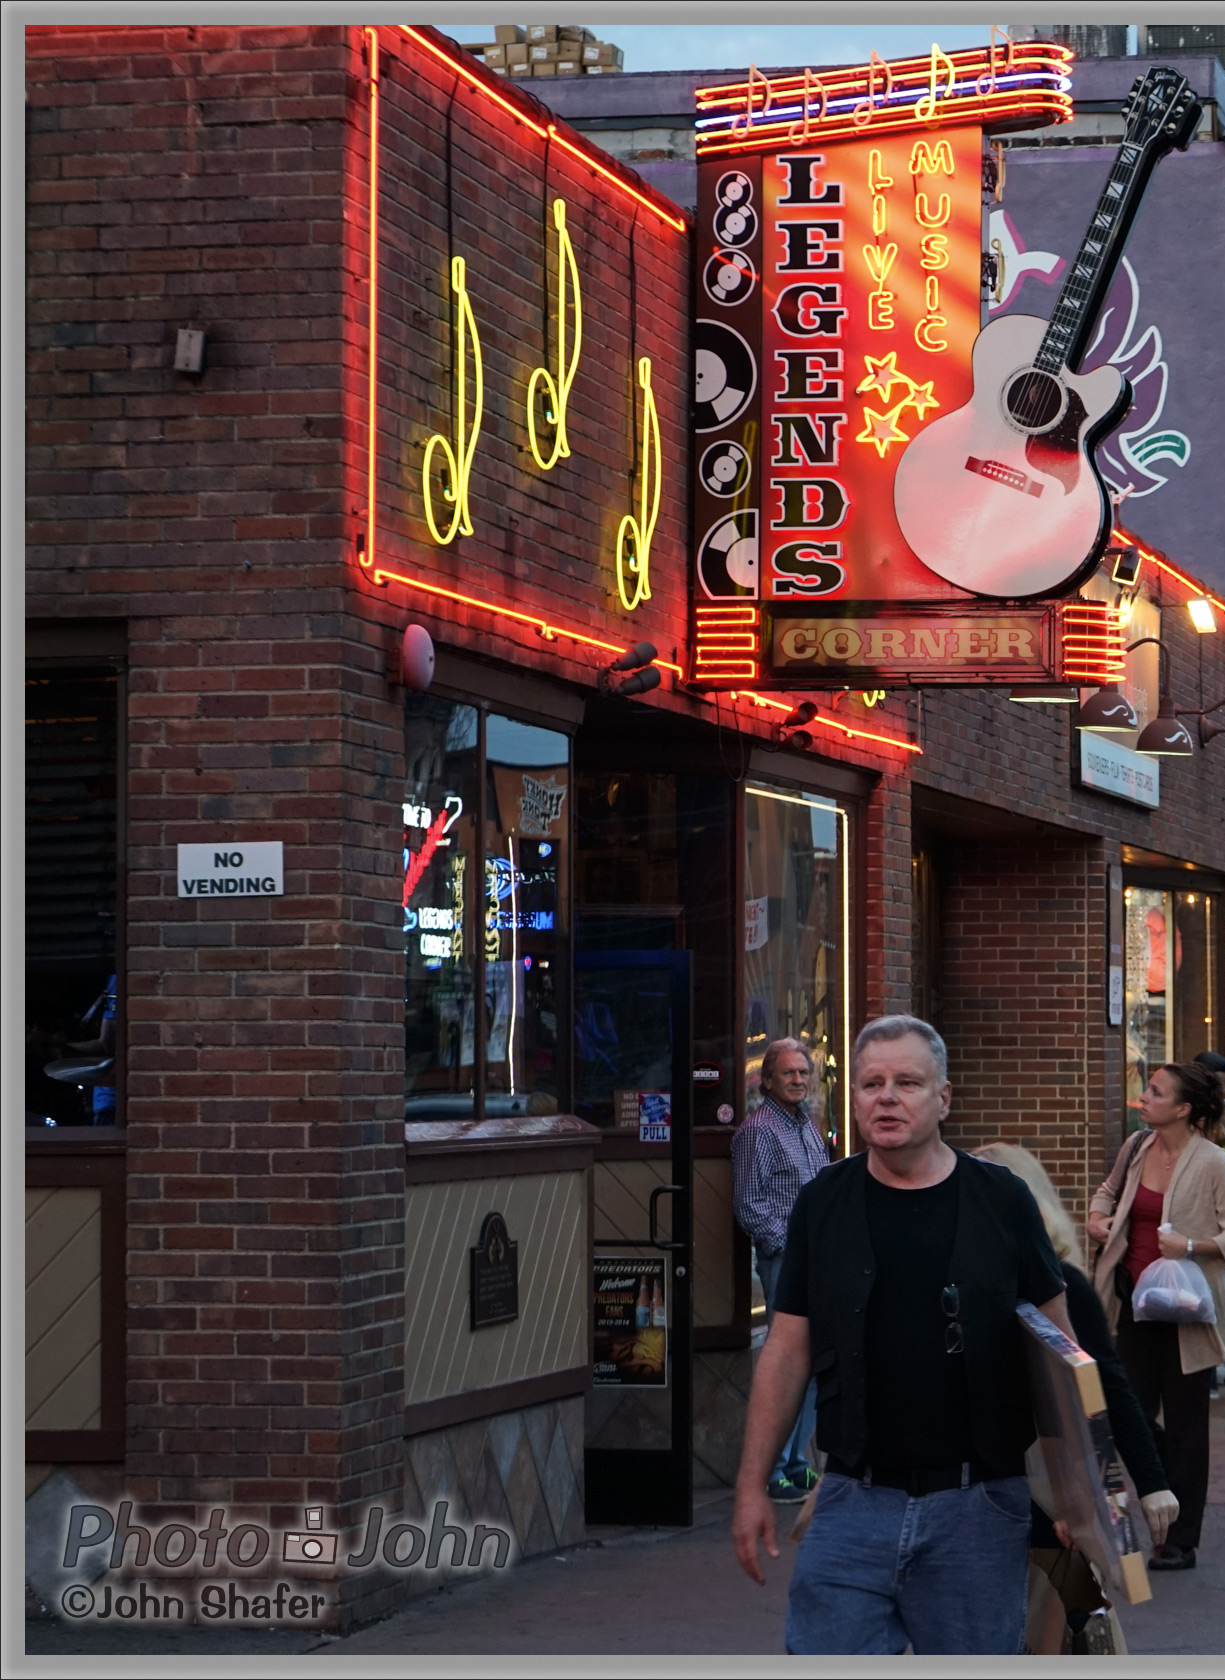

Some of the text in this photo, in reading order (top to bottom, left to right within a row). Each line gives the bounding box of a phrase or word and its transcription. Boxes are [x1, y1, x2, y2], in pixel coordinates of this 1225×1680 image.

[862, 149, 899, 331] LIVE
[908, 138, 955, 353] MUSIC
[770, 152, 850, 597] LEGENDS
[779, 626, 1036, 661] CORNER
[214, 852, 244, 868] NO
[182, 877, 276, 894] VENDING
[623, 1092, 634, 1100] NO
[642, 1127, 667, 1140] PULL
